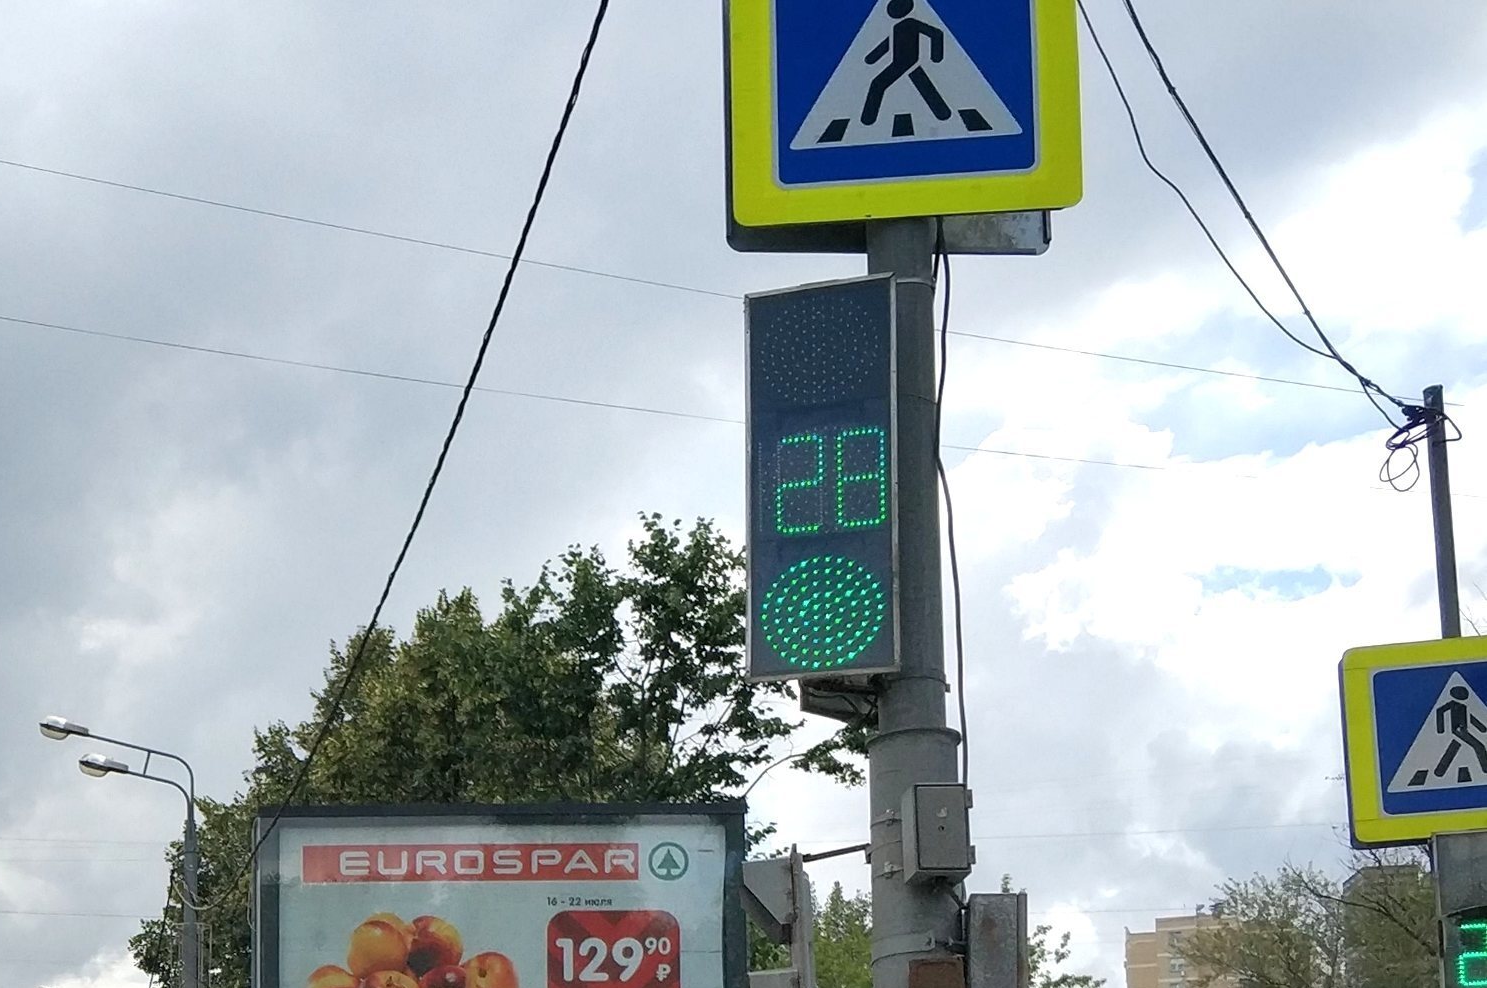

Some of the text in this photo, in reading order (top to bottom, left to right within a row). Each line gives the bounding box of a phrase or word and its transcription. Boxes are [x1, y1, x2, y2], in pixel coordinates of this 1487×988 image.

[775, 426, 886, 535] 28
[339, 849, 635, 875] EUROSPAR
[547, 896, 557, 906] 16
[568, 896, 581, 906] 22
[584, 898, 613, 906] июля
